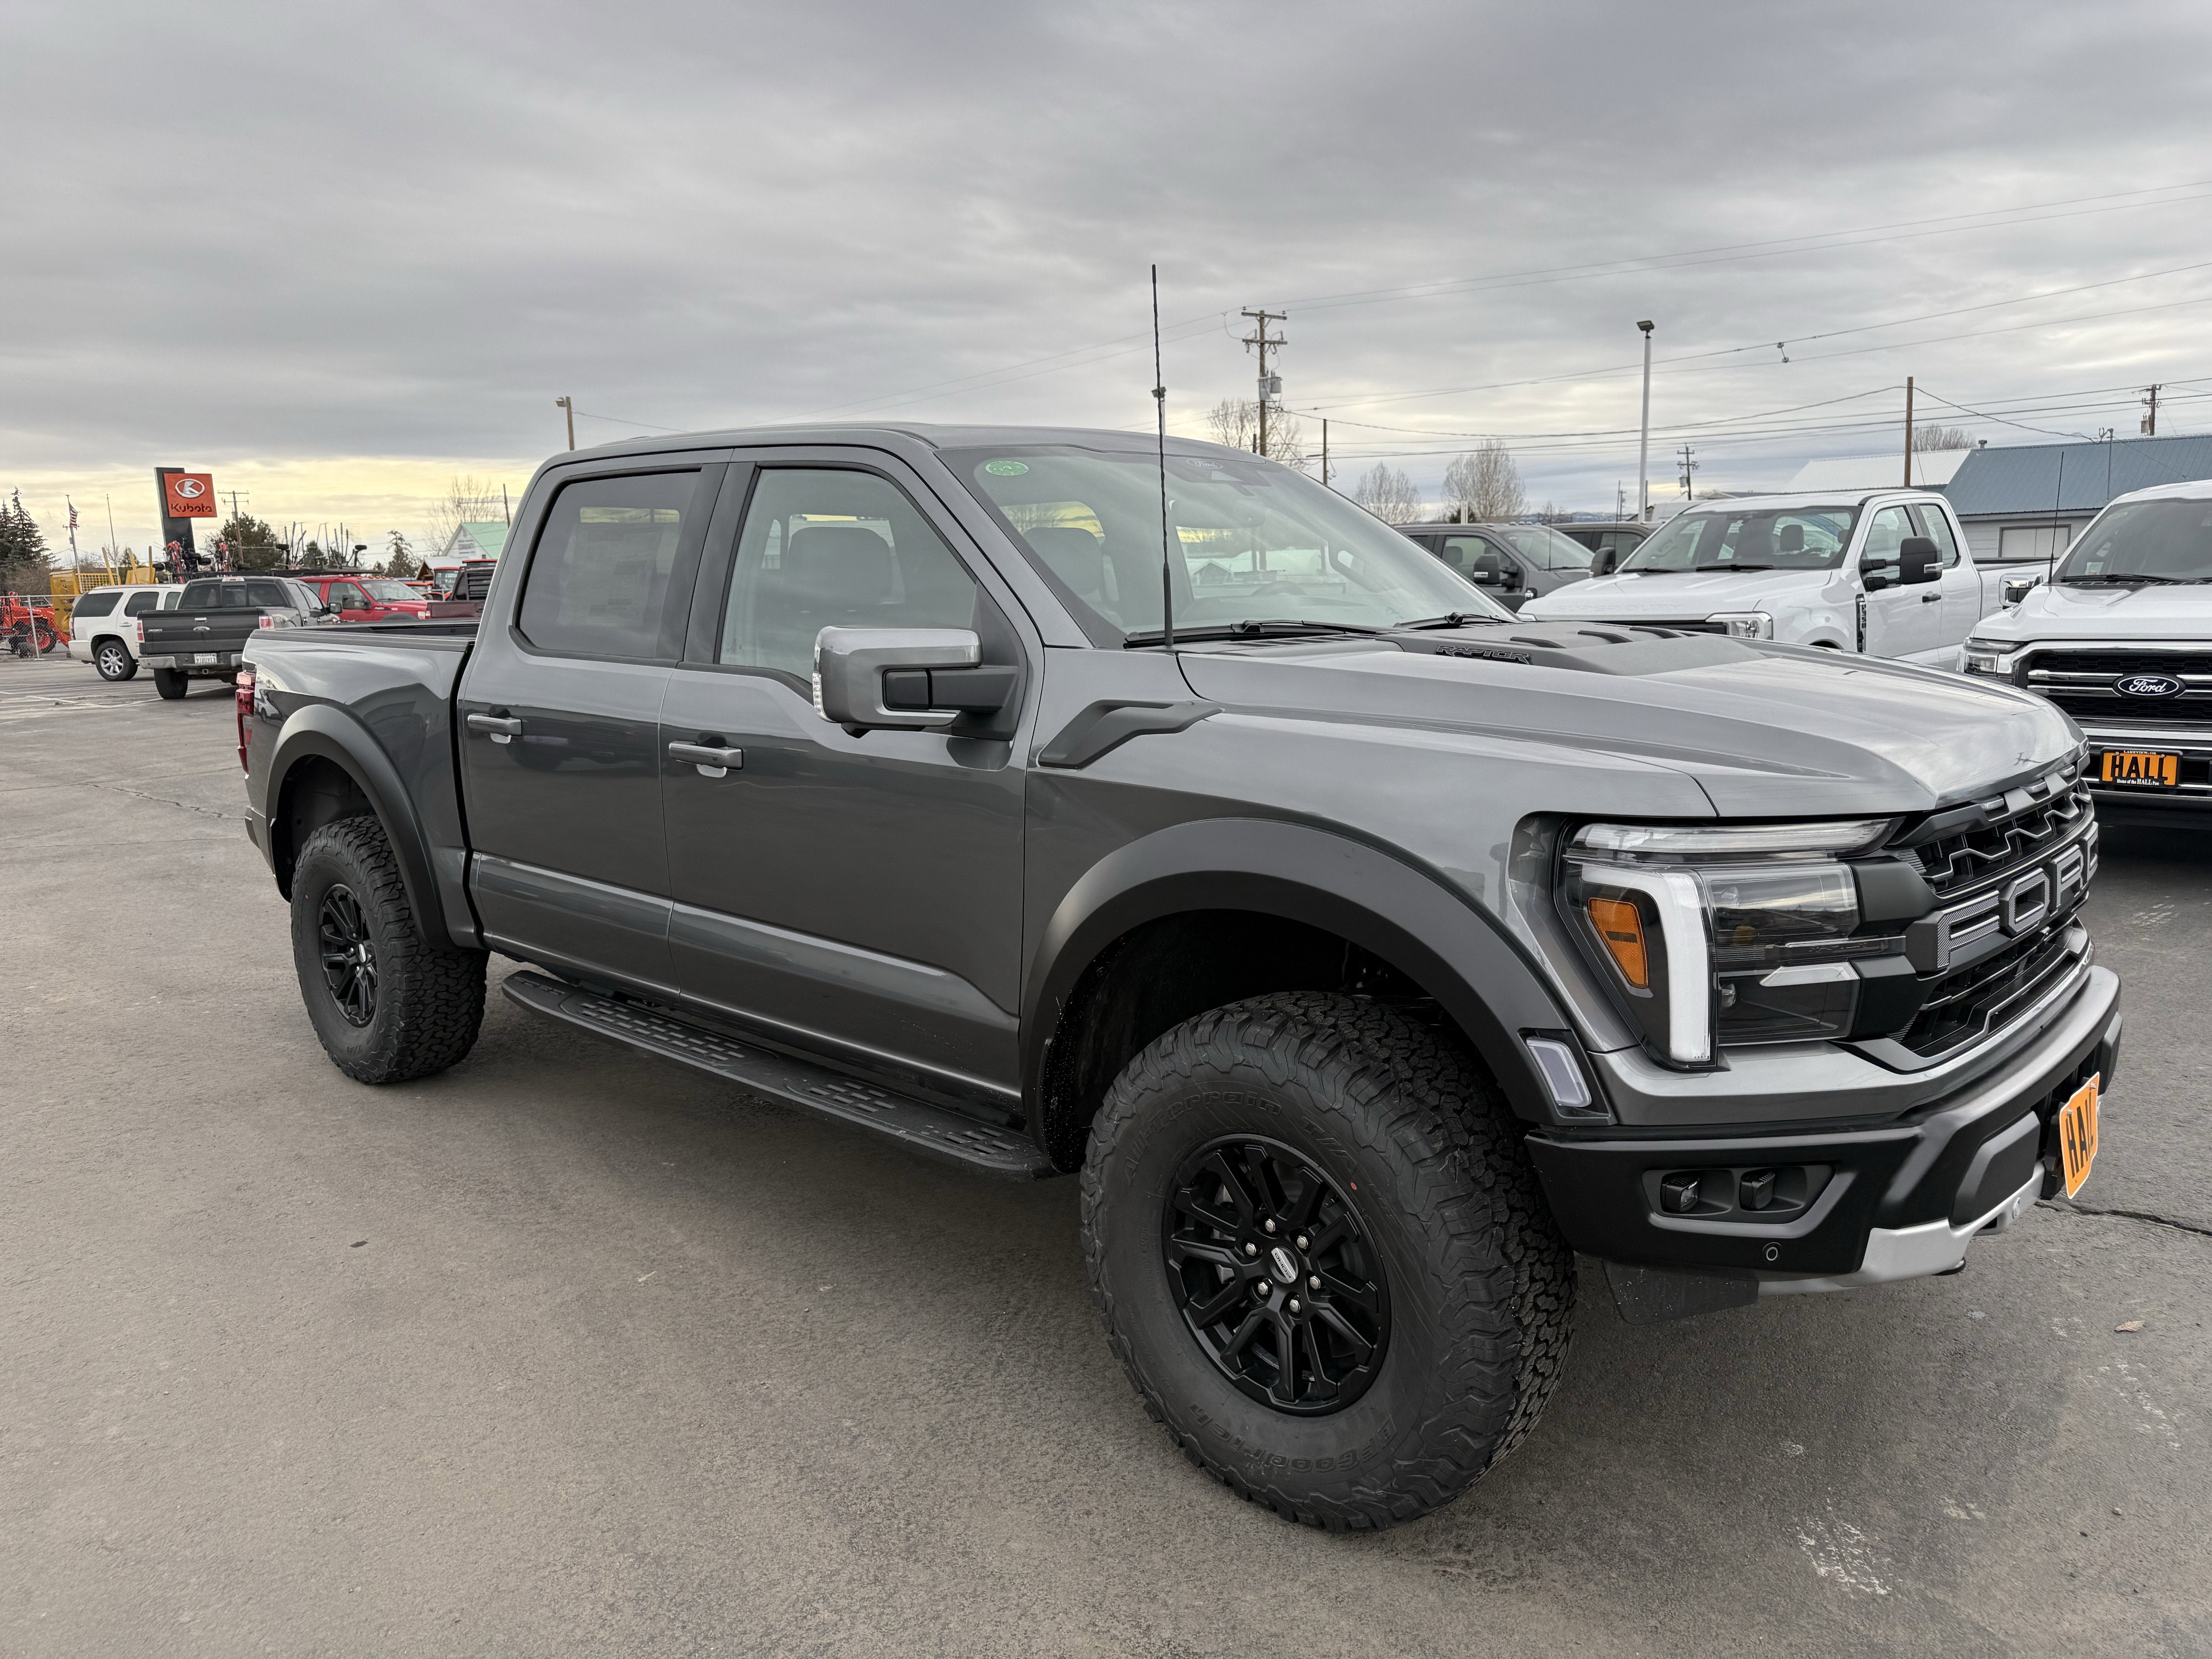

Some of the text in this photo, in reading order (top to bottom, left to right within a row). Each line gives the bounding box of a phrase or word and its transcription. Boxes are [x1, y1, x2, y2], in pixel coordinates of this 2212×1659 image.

[171, 503, 213, 512] Kubota
[1436, 645, 1530, 665] RAPTOR
[2129, 678, 2167, 692] Ford
[2111, 755, 2169, 780] HALL
[1124, 1091, 1283, 1186] All-Terrain
[2066, 1090, 2094, 1178] HALL
[1188, 1401, 1398, 1474] BFGoodrich
